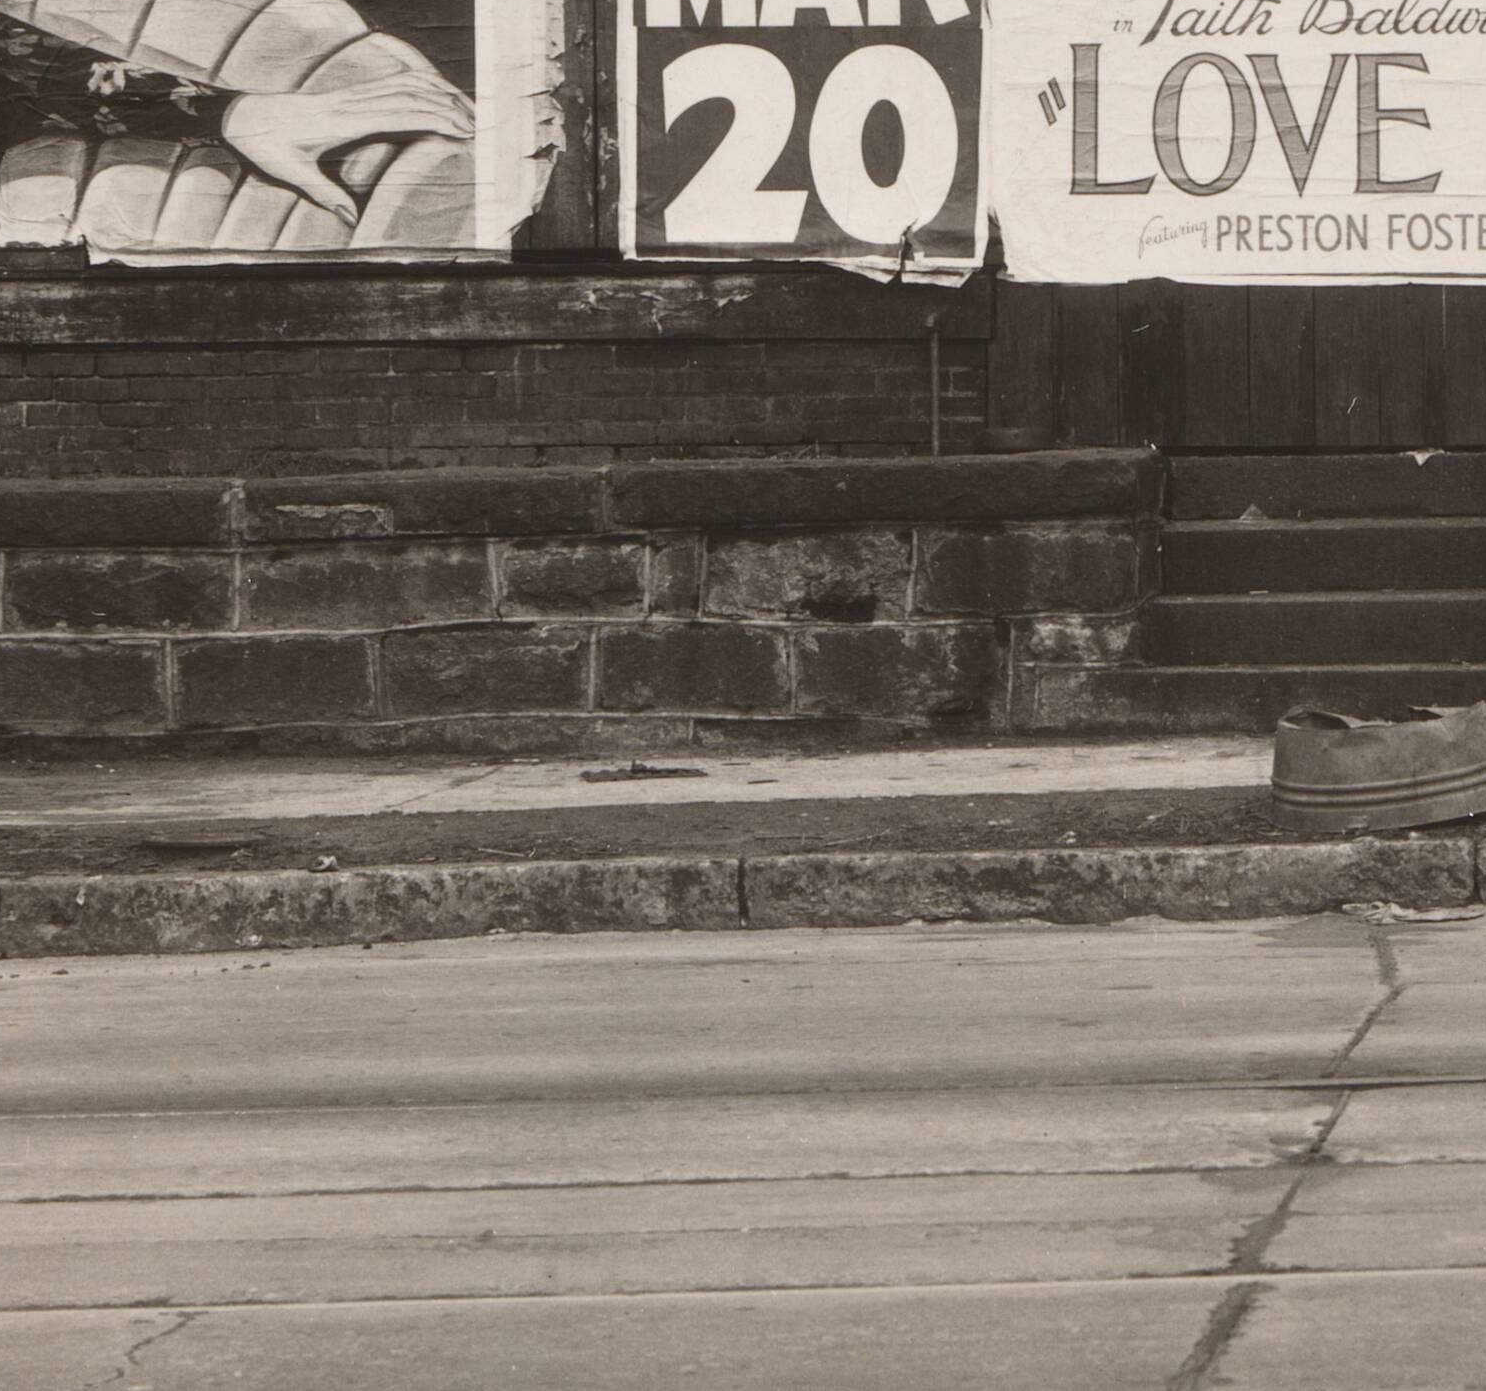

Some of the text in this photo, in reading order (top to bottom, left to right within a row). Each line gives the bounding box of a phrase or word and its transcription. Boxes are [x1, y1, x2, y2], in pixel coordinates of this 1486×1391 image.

[1112, 18, 1133, 34] in
[662, 43, 959, 244] 20
[1138, 215, 1208, 259] featuring
[1215, 214, 1369, 253] PRESTON
